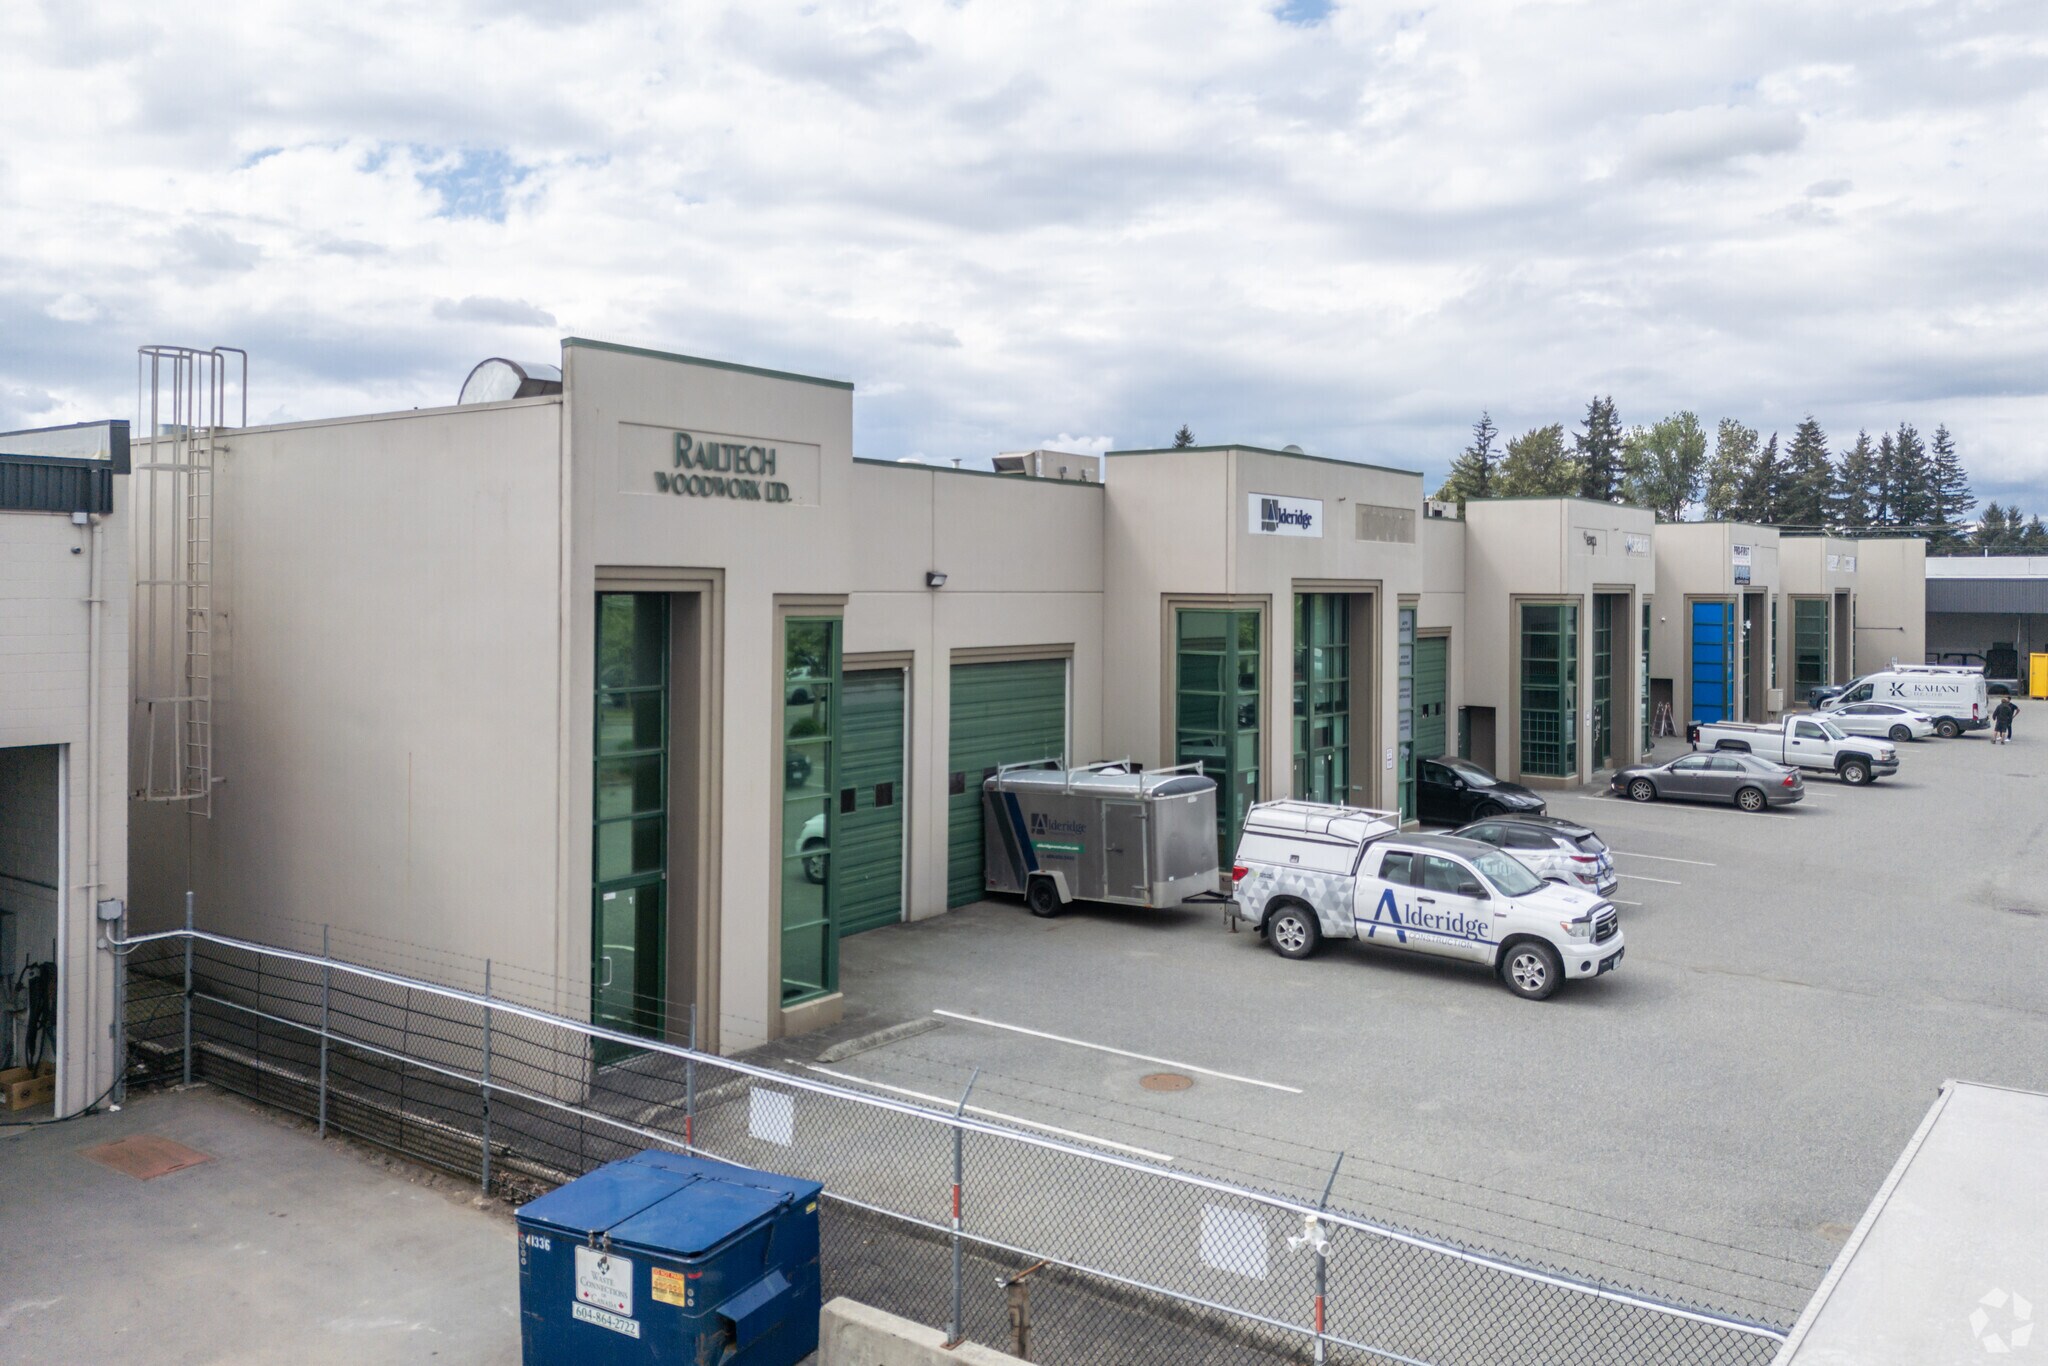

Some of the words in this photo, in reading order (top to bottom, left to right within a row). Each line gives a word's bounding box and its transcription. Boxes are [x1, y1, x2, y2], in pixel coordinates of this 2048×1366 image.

[673, 431, 776, 476] RAILTECH
[654, 472, 761, 500] WOODWORK
[764, 481, 792, 503] LTD.
[1261, 498, 1313, 532] Alderidge
[1914, 684, 1959, 693] KAHANI
[1030, 813, 1087, 836] Alderidge
[1368, 888, 1489, 944] Alderidge
[1408, 932, 1474, 950] CONSTRUCTION
[525, 1233, 551, 1252] 41336
[579, 1275, 629, 1300] CONNECTIONS
[591, 1270, 615, 1287] WASTE
[591, 1293, 617, 1310] CANADA
[575, 1306, 636, 1334] 604-864-2722
